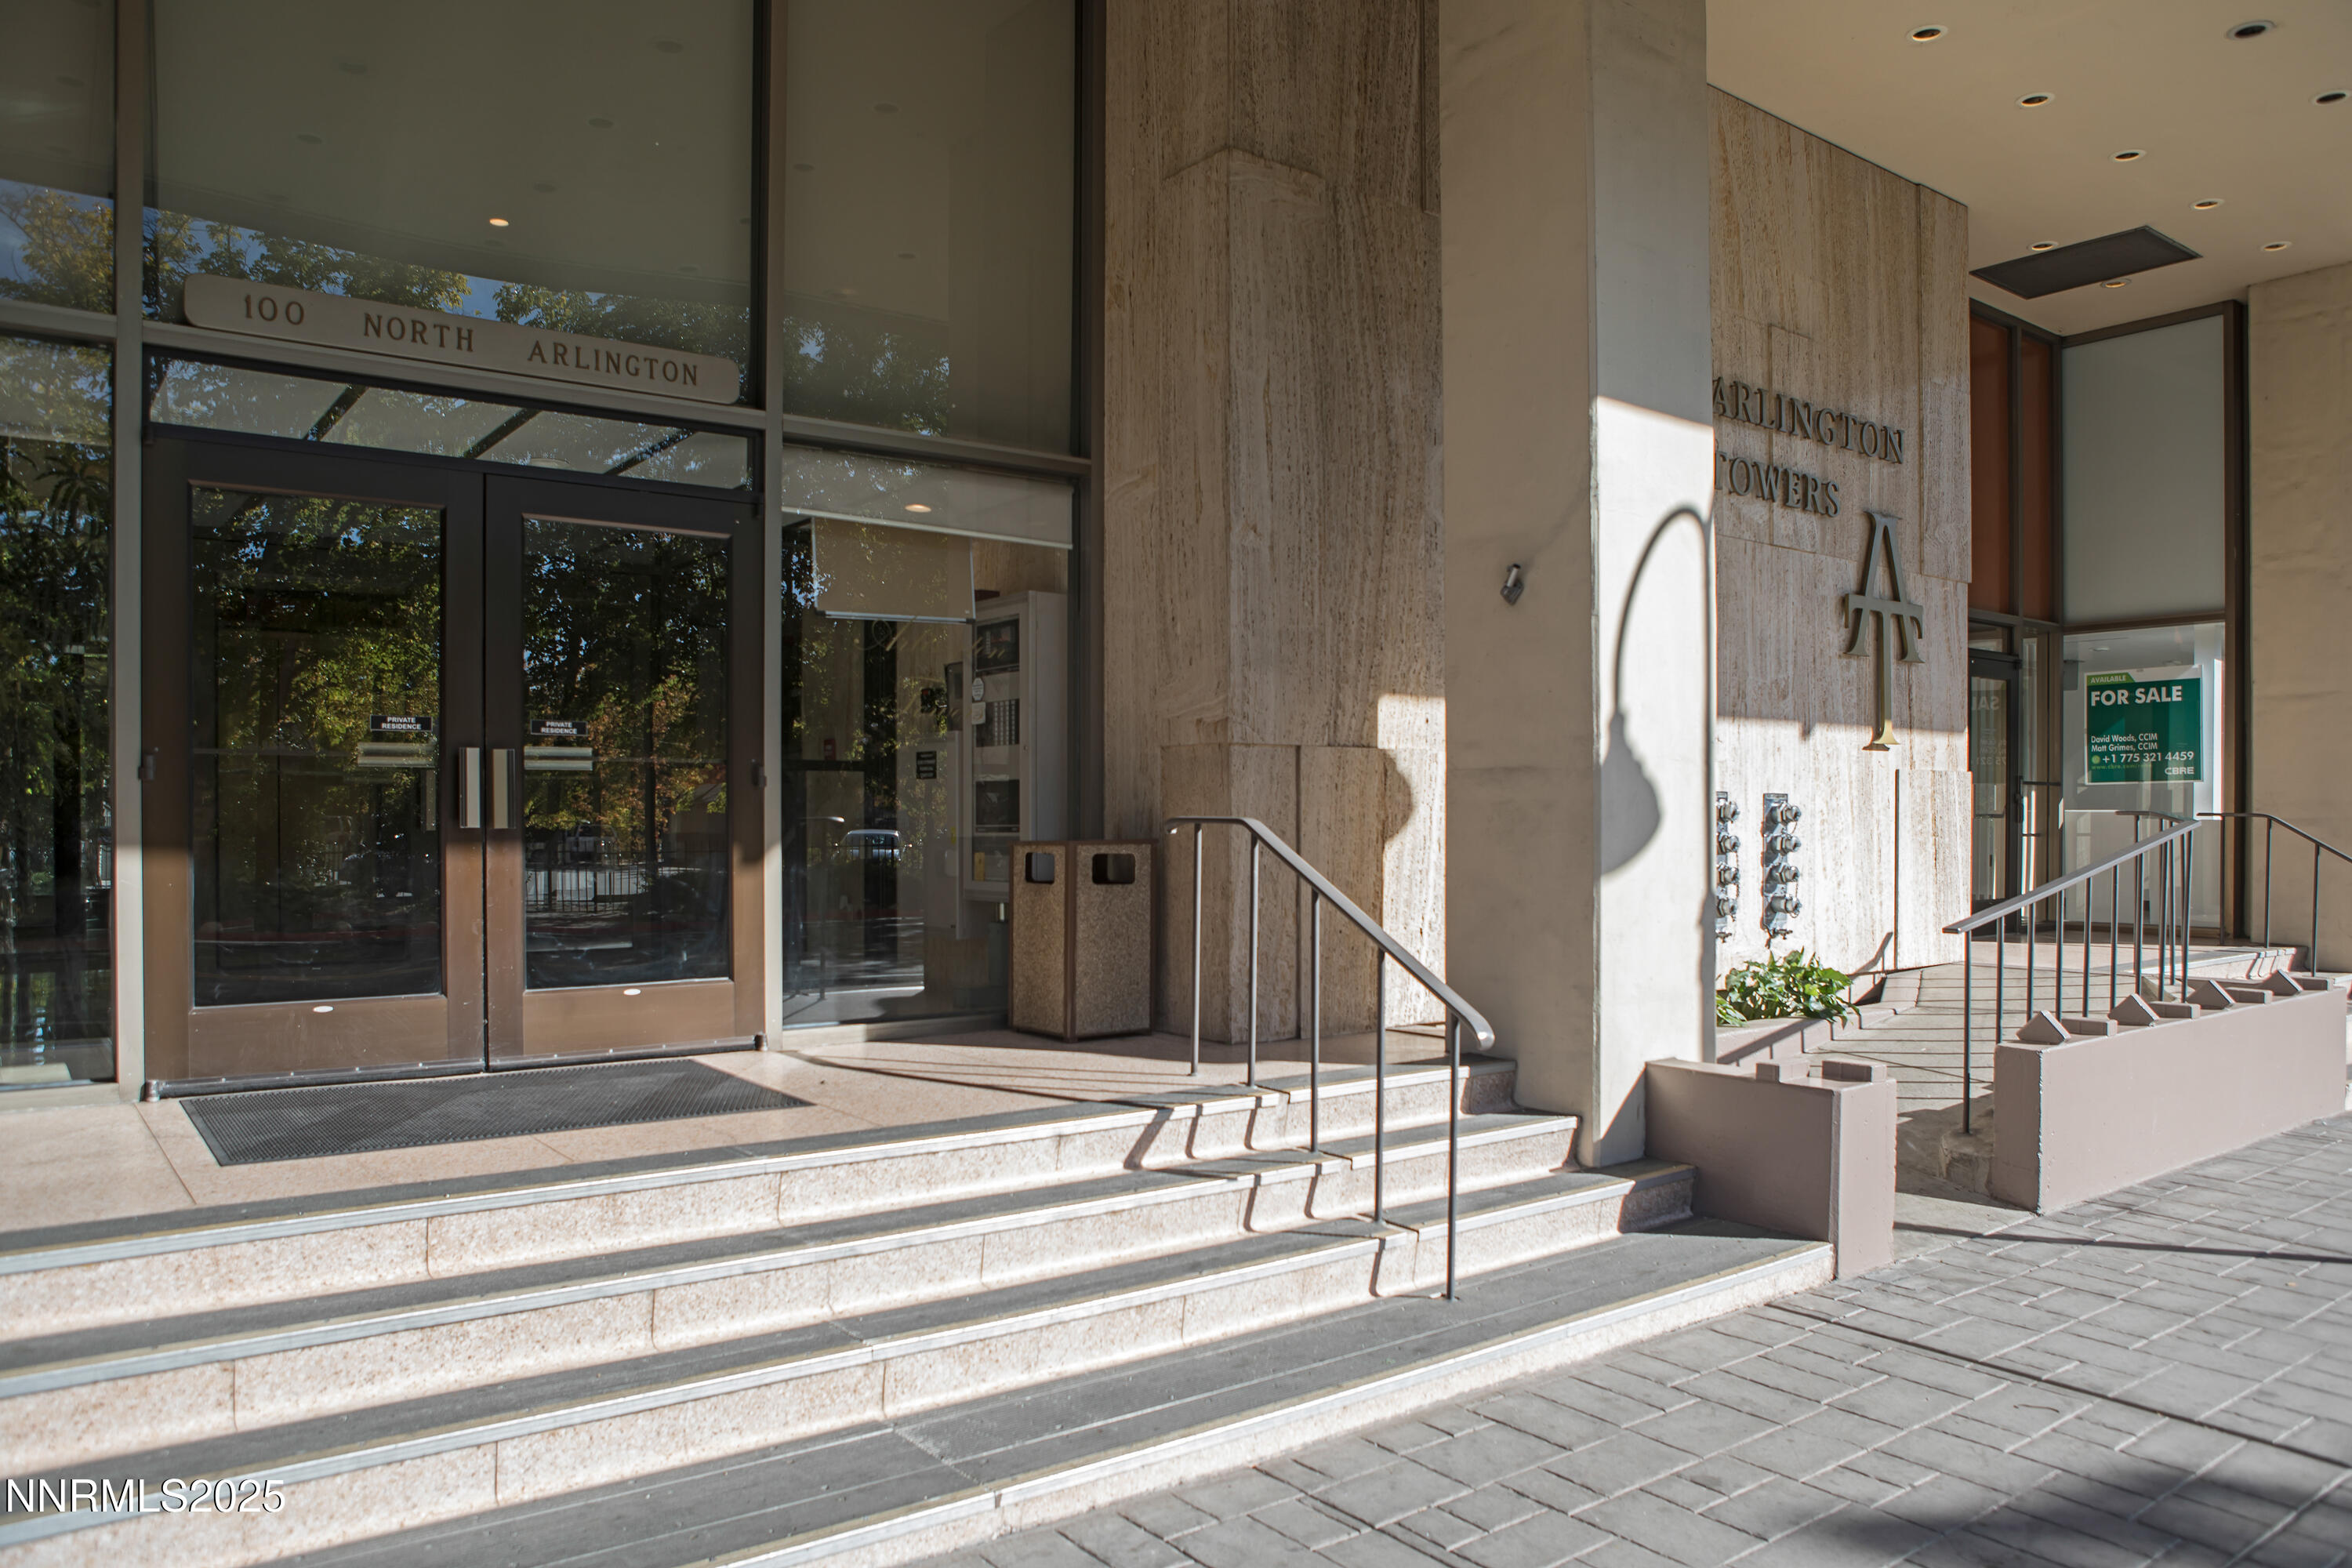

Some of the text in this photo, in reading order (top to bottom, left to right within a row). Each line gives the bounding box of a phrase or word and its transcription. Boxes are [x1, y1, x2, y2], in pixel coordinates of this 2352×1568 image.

[243, 293, 699, 387] 100 NORTH ARLINGTON
[1712, 376, 1905, 464] ARLINGTON
[2090, 674, 2127, 684] AVAILABLE
[2091, 685, 2183, 706] FOR SALE
[2091, 735, 2111, 743] David
[2138, 733, 2158, 742] CCIM
[2091, 744, 2107, 753] Matt
[2108, 743, 2136, 752] Grimes,
[2102, 751, 2194, 764] +1 775 321 4459
[2165, 766, 2194, 775] CBRE
